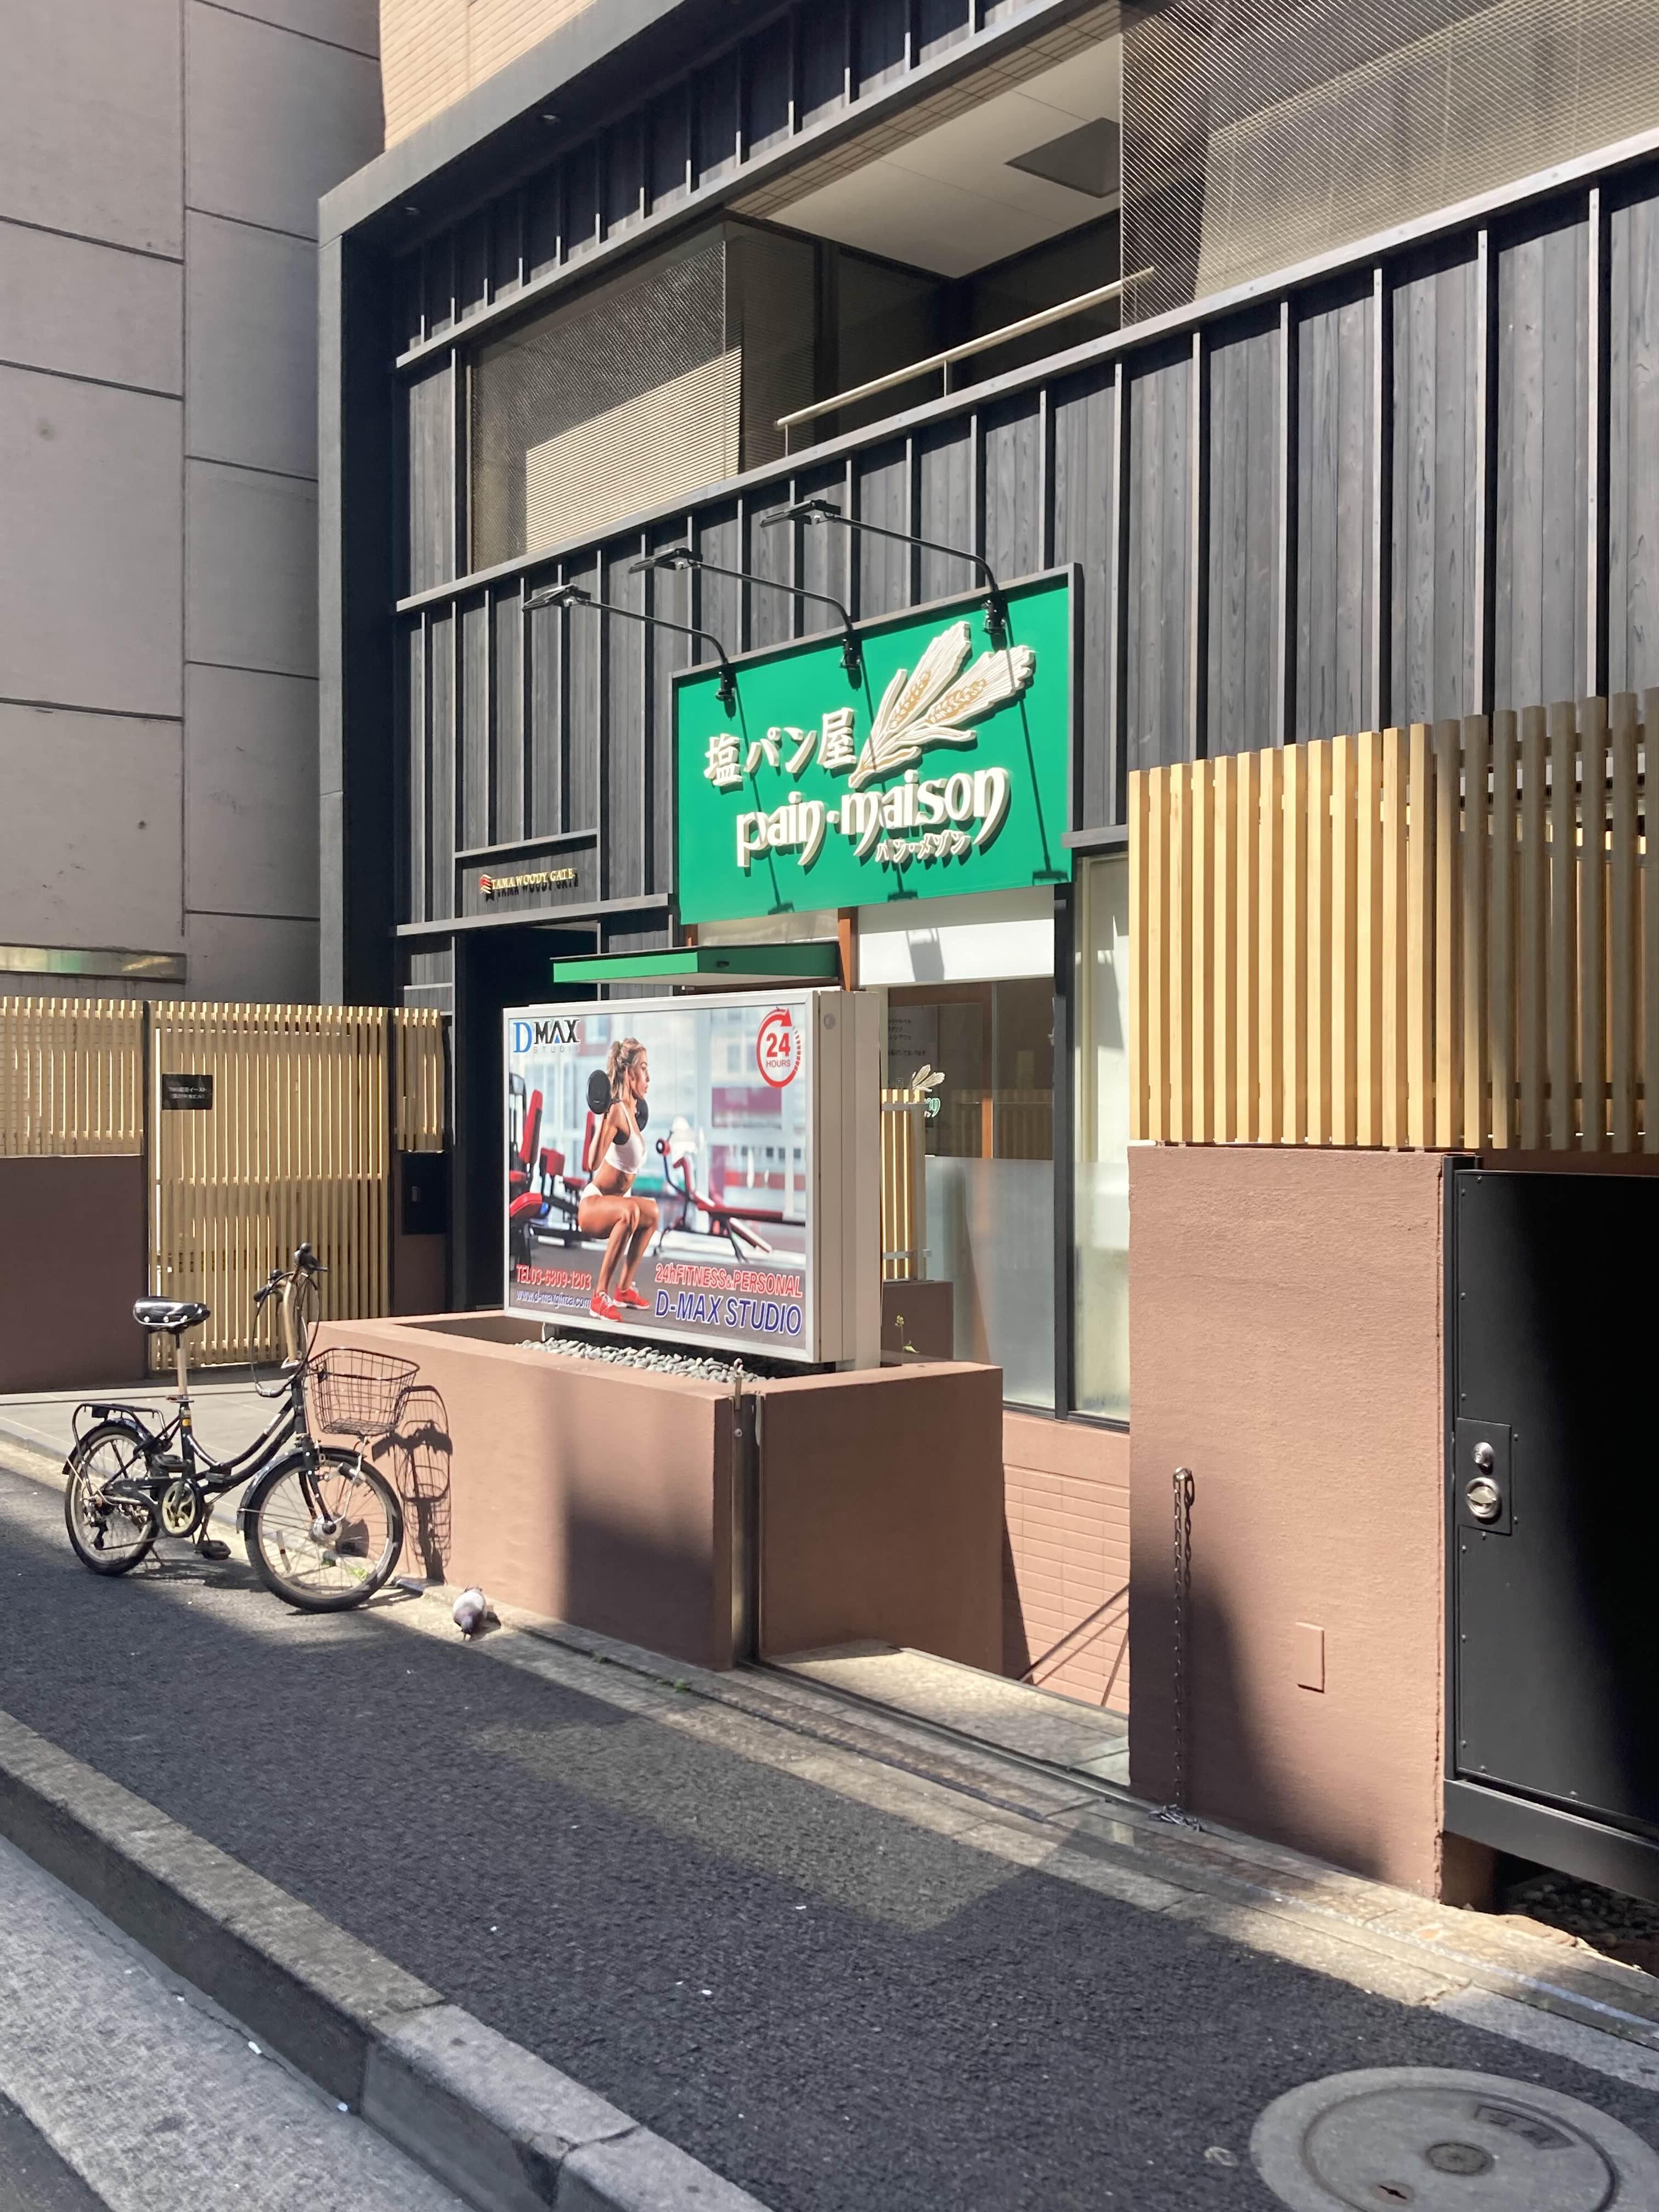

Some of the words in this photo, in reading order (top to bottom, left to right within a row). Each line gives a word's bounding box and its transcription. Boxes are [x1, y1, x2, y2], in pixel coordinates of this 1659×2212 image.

[703, 707, 857, 787] 塩パン屋
[516, 872, 548, 886] WOODY
[550, 868, 575, 882] GATE
[766, 1032, 791, 1057] 24
[766, 1059, 791, 1068] HOURS
[655, 1289, 724, 1325] D-MAX
[724, 1296, 802, 1336] STUDIO
